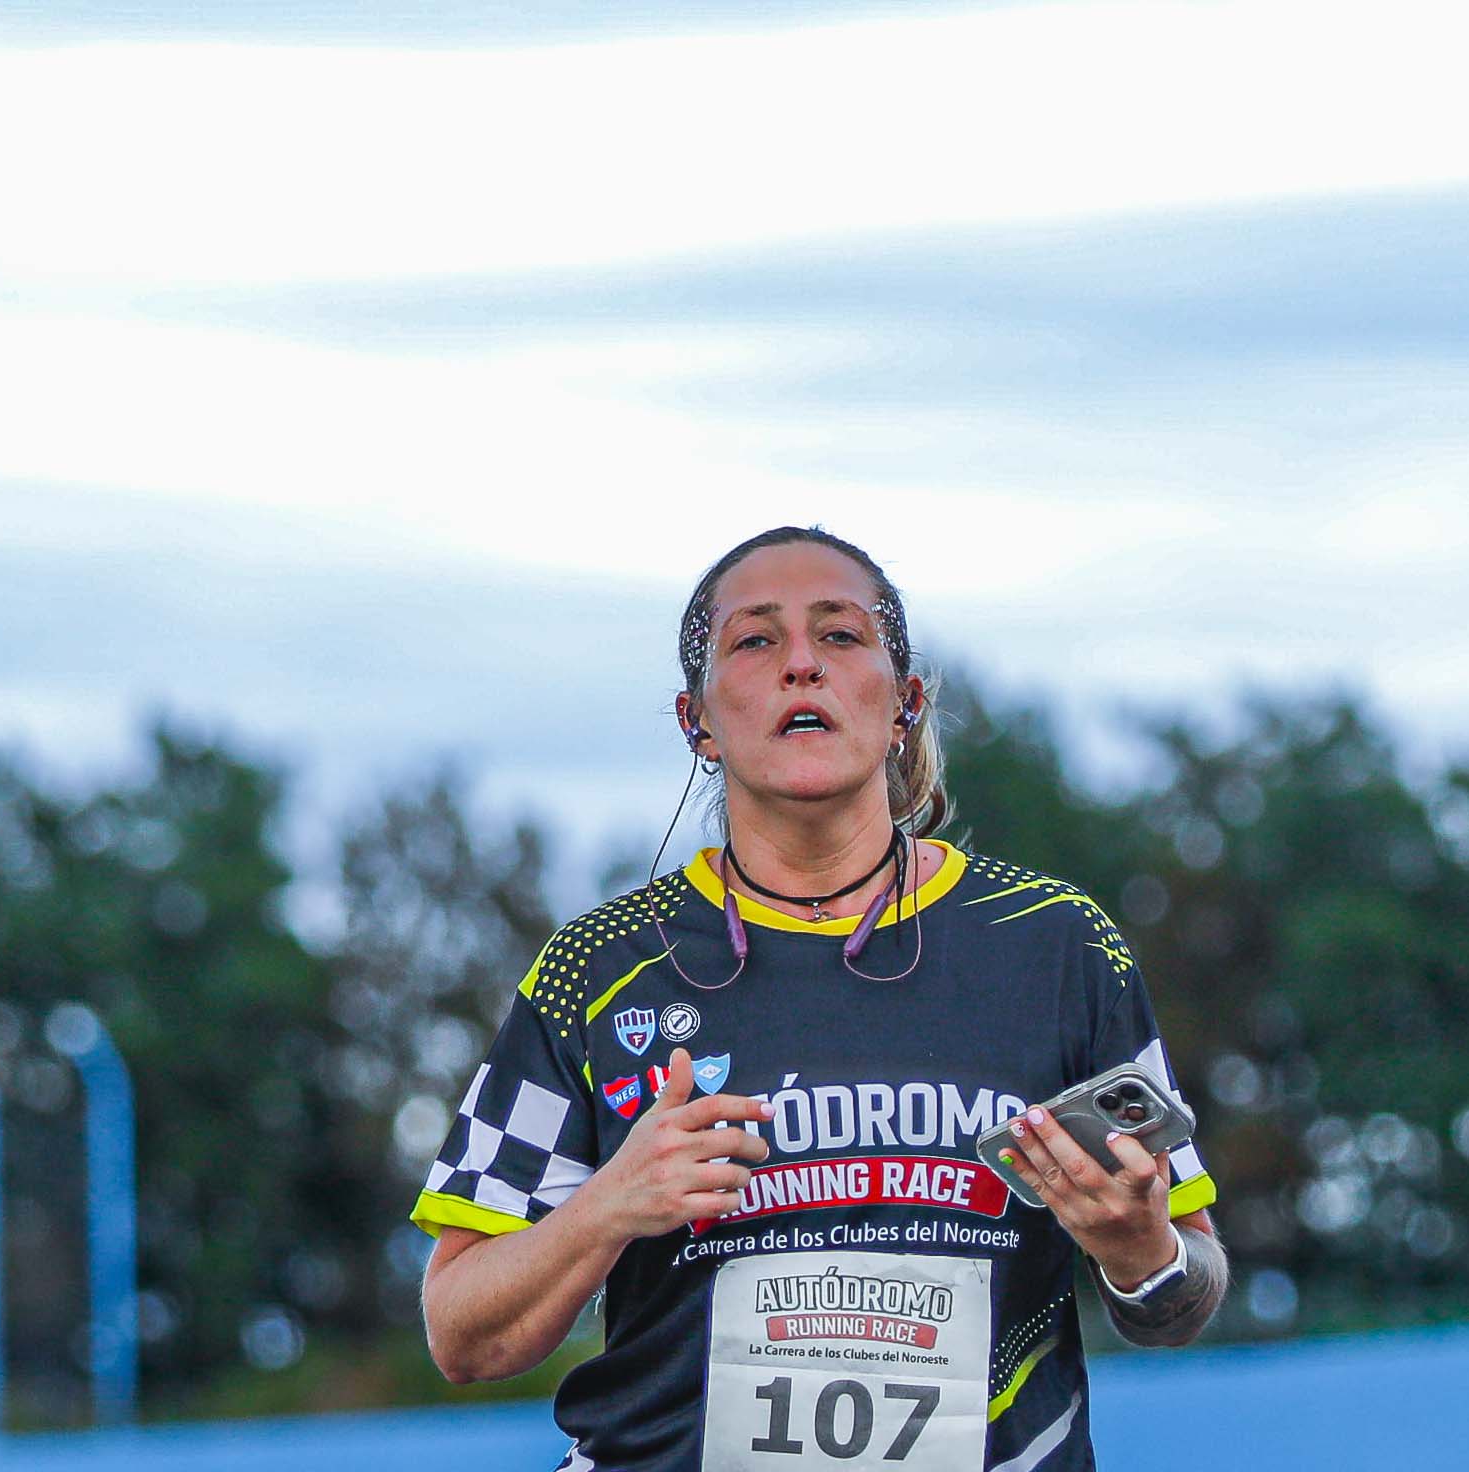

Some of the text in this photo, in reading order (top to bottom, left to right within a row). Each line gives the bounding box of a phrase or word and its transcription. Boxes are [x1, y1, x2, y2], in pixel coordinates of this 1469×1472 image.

[614, 1085, 636, 1105] NEC
[720, 1162, 976, 1219] UNNING RACE
[683, 1236, 756, 1261] Carrera
[761, 1229, 788, 1250] de
[794, 1227, 824, 1248] los
[830, 1221, 899, 1245] Clubes
[905, 1220, 938, 1242] del
[944, 1222, 1020, 1248] Noroeste
[755, 1266, 953, 1323] AUTÓDROMO
[786, 1316, 919, 1344] RUNNING RACE
[749, 1343, 949, 1366] La Carrera de los Clubes del Noroeste
[751, 1376, 941, 1461] 107
